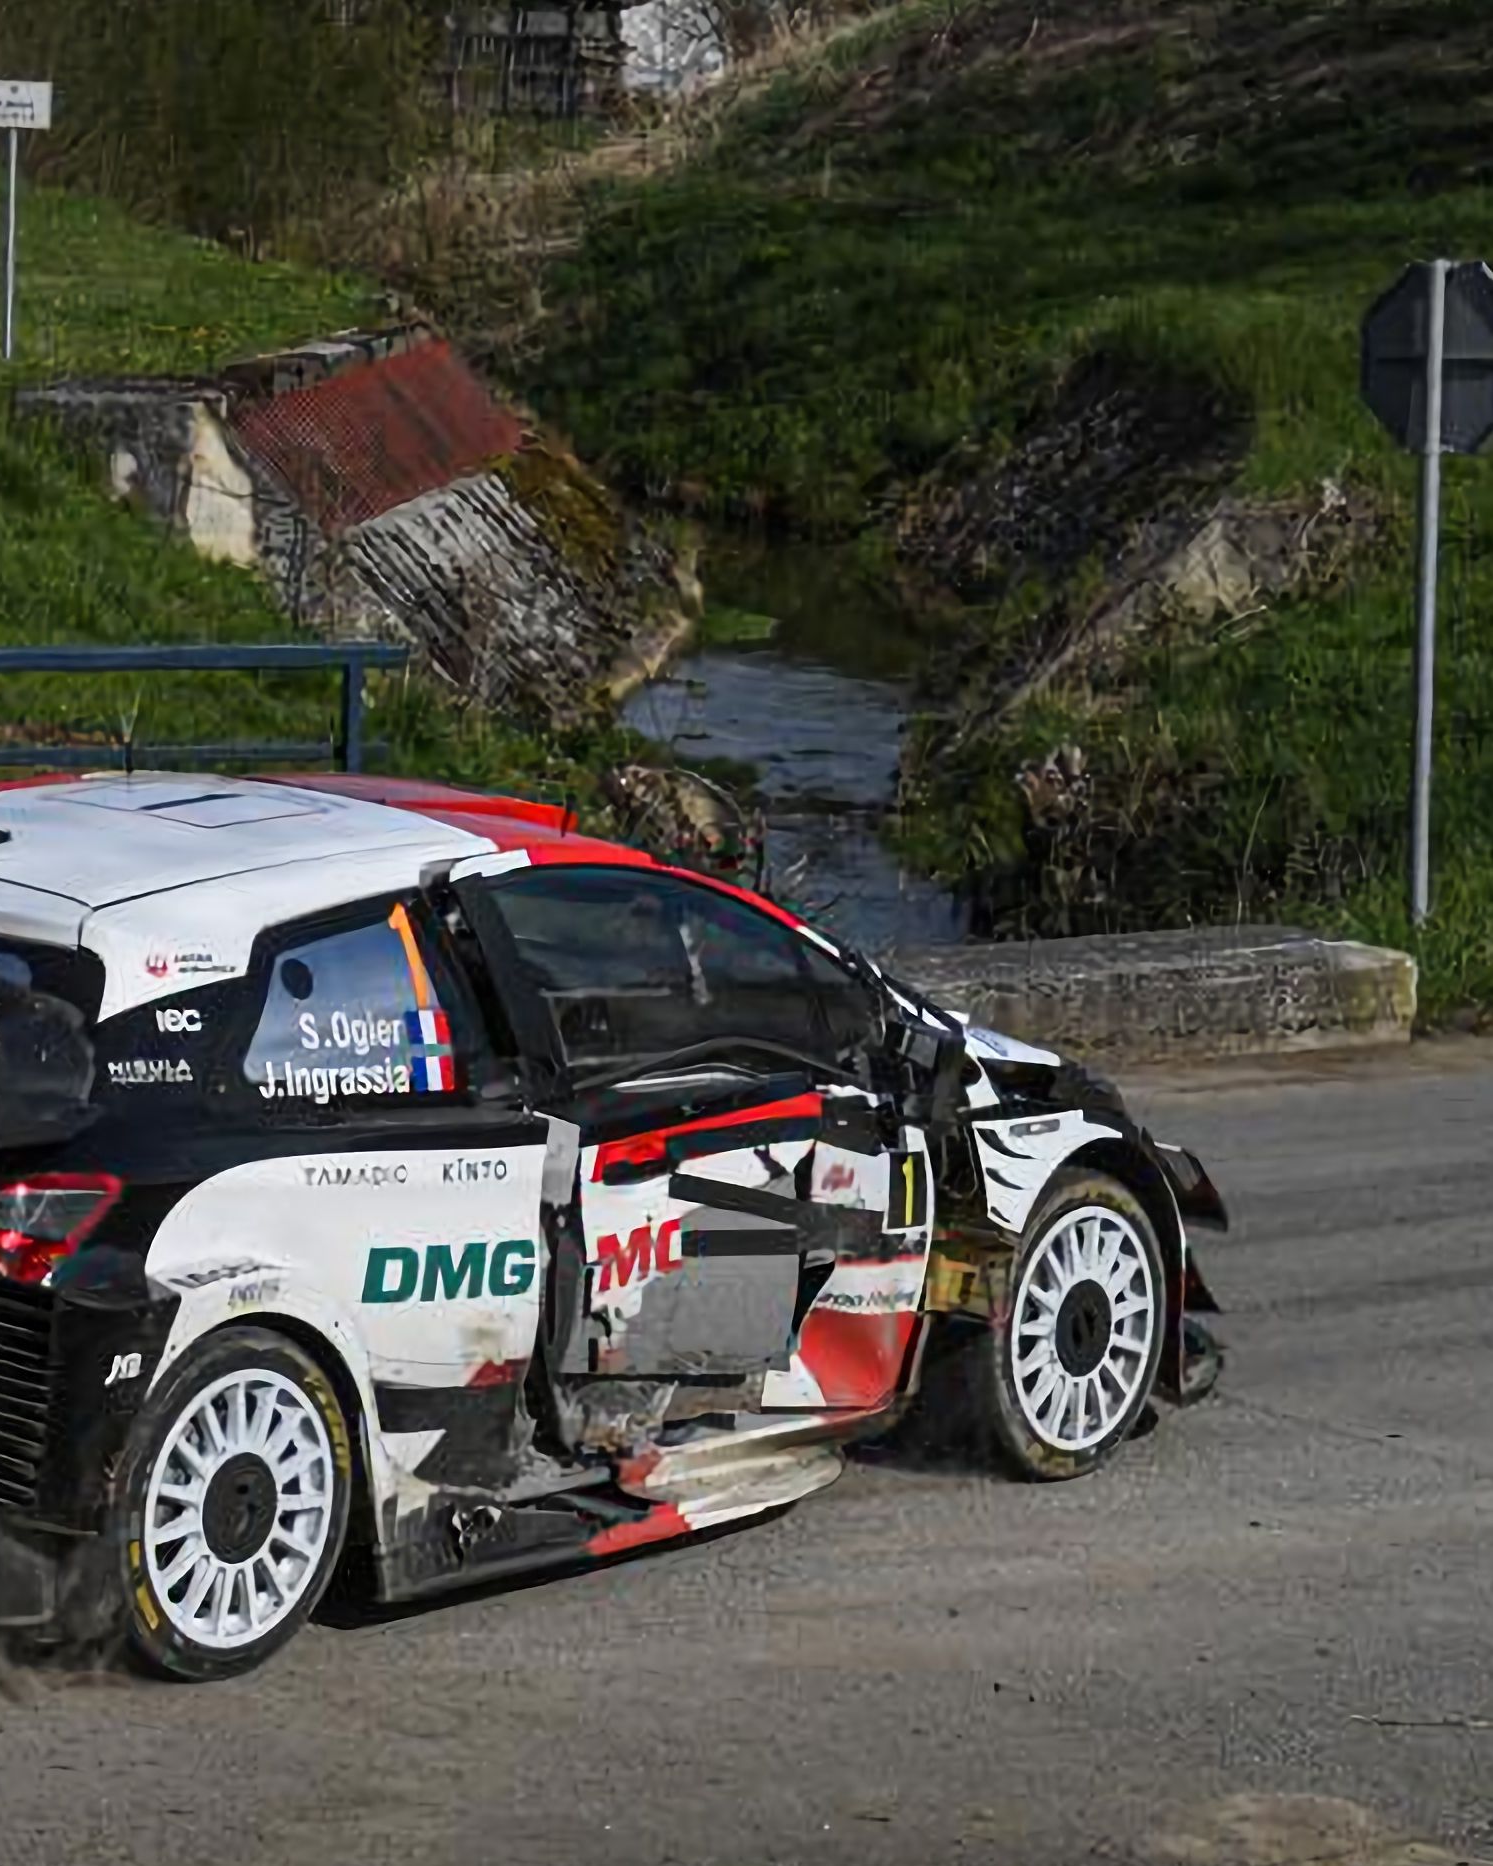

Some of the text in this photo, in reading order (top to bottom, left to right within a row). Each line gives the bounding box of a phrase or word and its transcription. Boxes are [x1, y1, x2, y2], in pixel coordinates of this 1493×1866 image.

[259, 1057, 411, 1104] J.Ingrassia
[902, 1155, 914, 1226] 1
[361, 1239, 536, 1304] DMG
